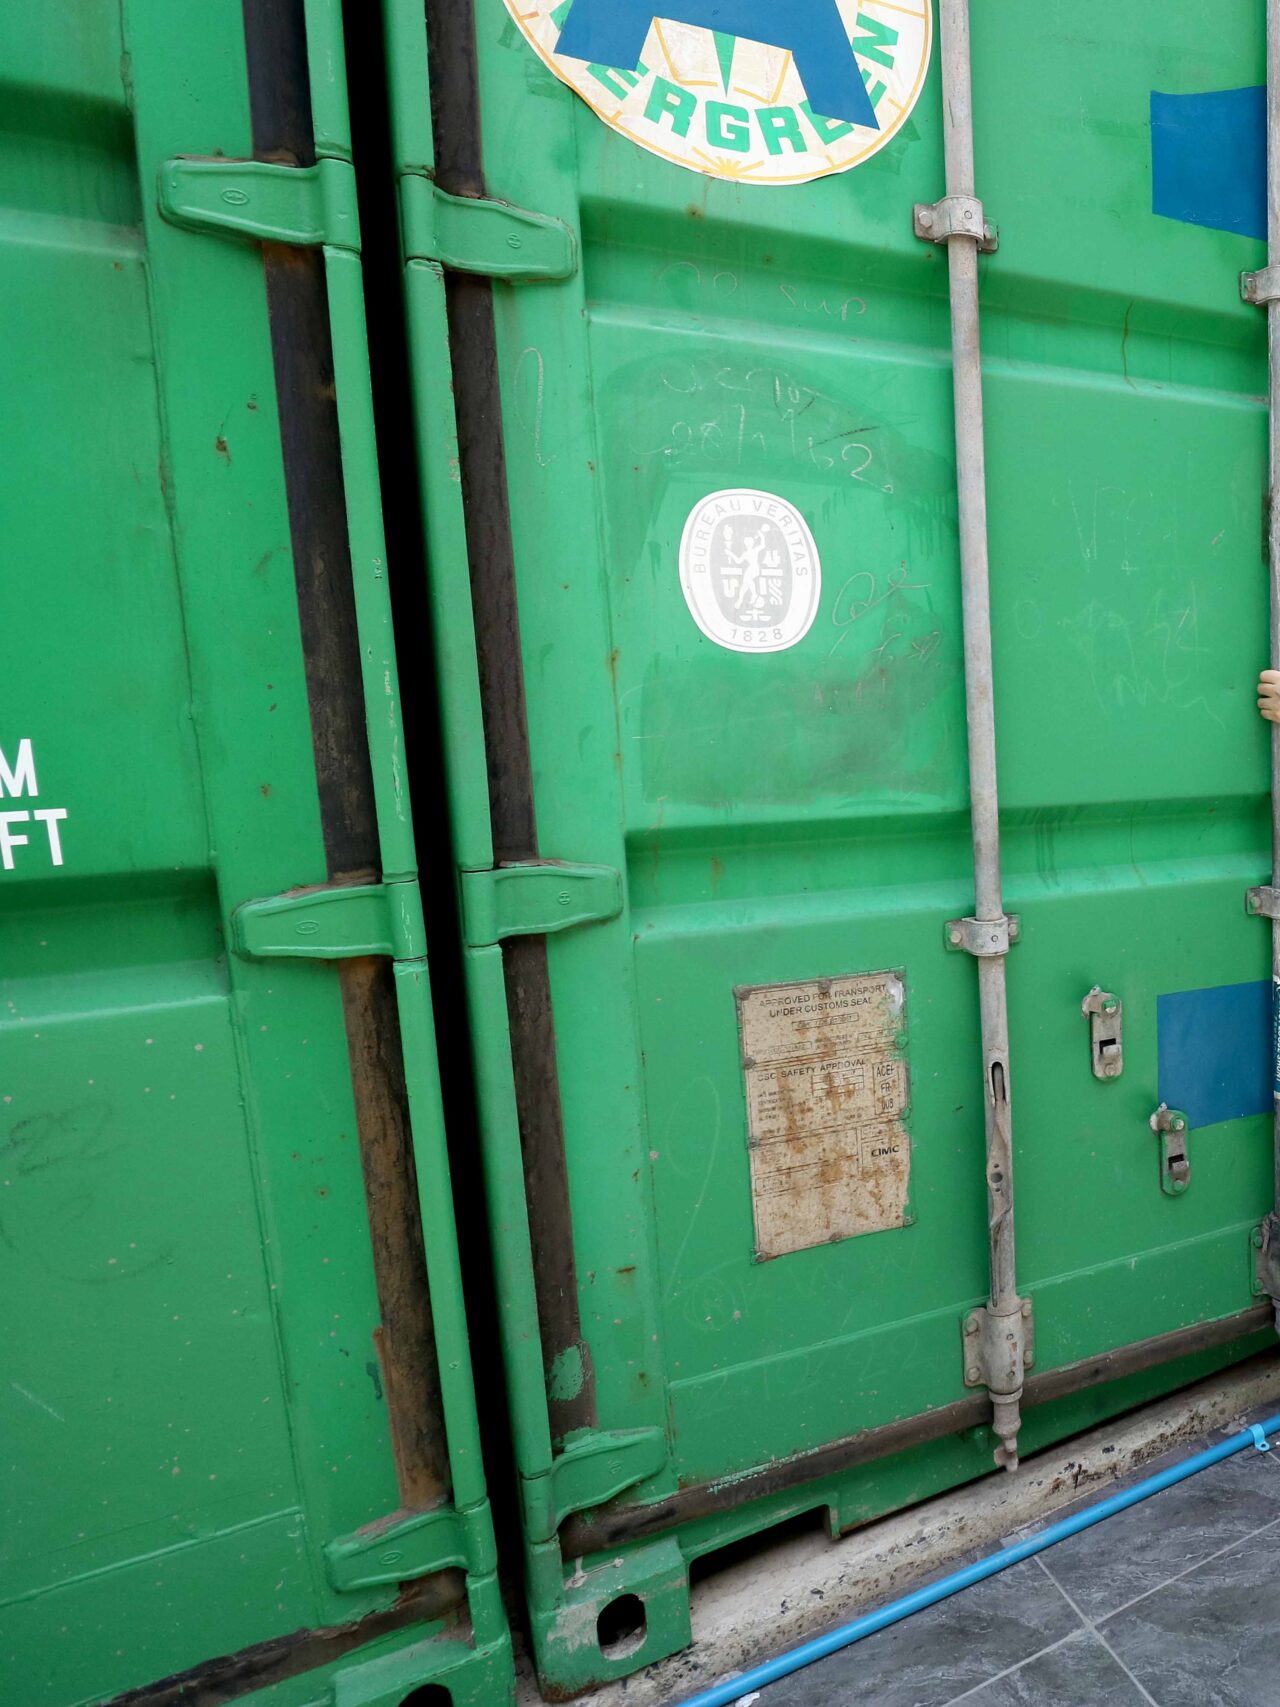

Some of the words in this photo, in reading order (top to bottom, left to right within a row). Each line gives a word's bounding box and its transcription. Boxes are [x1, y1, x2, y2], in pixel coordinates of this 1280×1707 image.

[693, 499, 742, 574] BUREAU
[752, 499, 809, 577] VERITAS
[730, 628, 784, 643] 1828
[0, 807, 68, 870] FT
[759, 994, 811, 1007] APPROVED
[812, 991, 833, 1001] FOR
[834, 983, 887, 999] TRANSPORT
[769, 1006, 803, 1018] UNDER
[804, 1000, 849, 1013] CUSTOMS
[850, 996, 873, 1007] SEAL
[781, 1065, 816, 1078] SAFETY
[871, 1145, 899, 1158] CIMC
